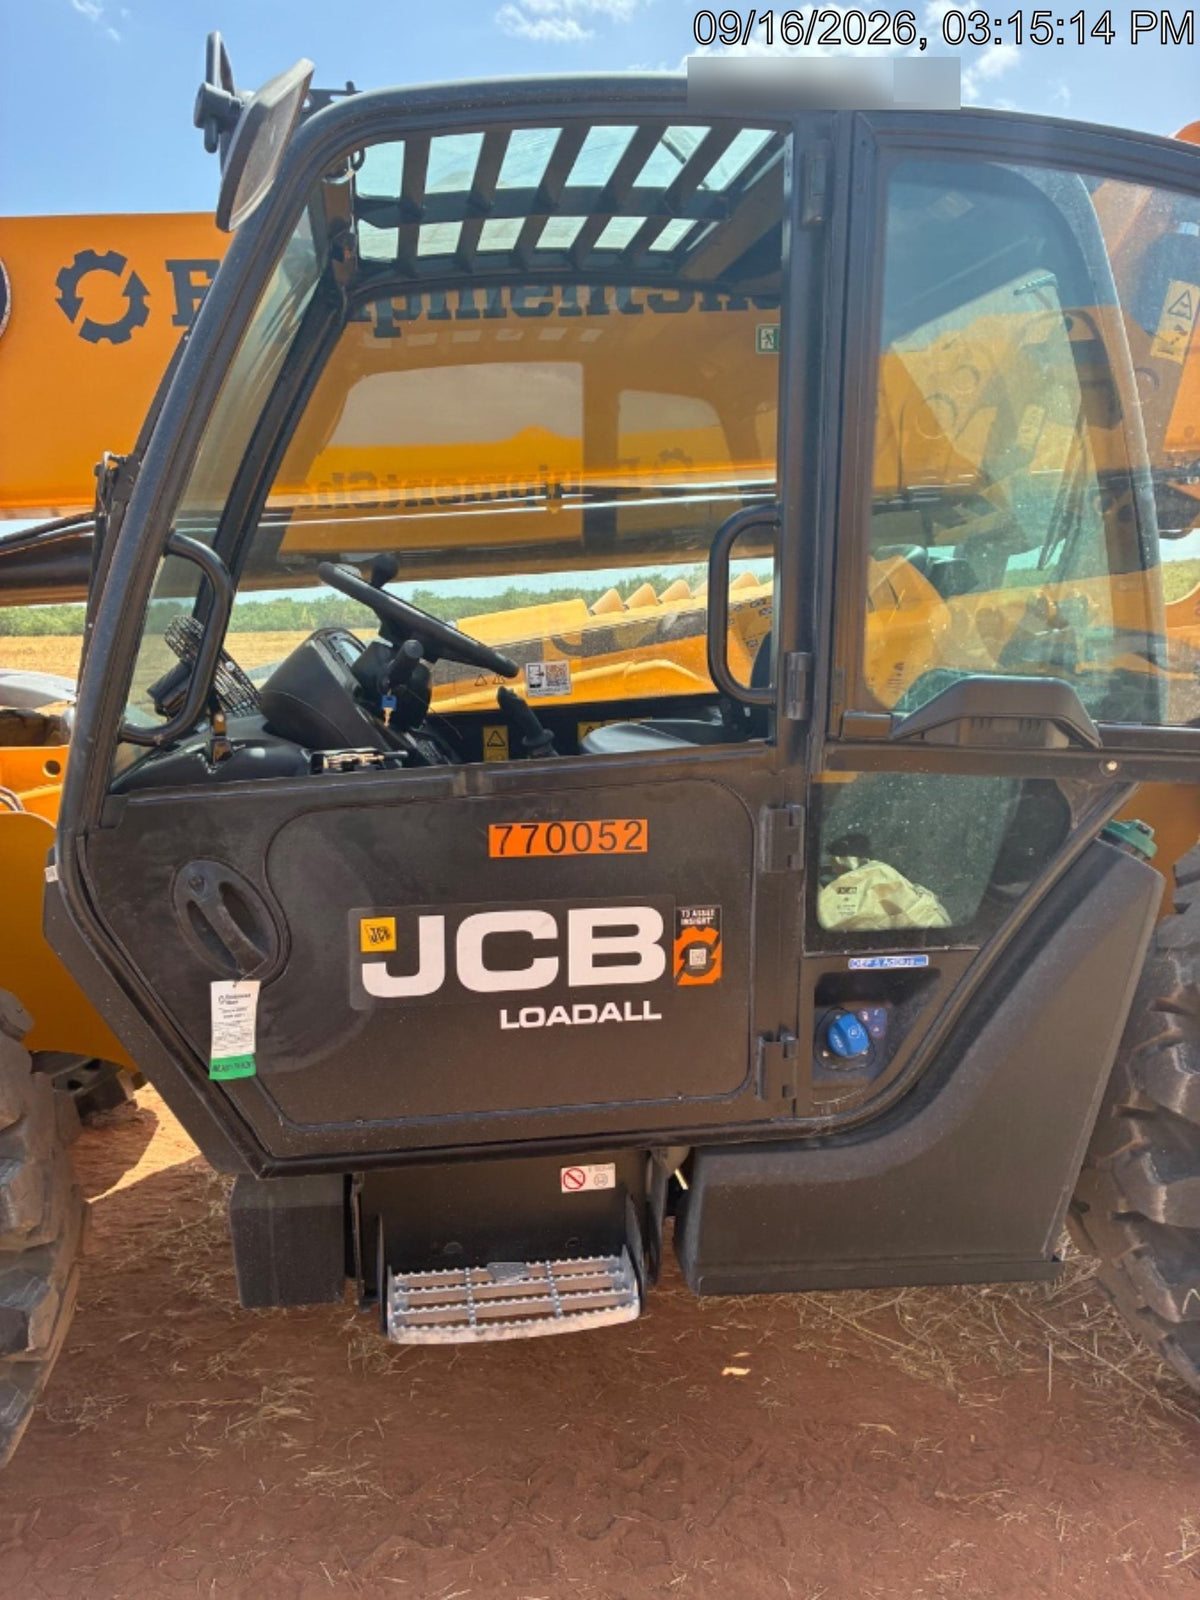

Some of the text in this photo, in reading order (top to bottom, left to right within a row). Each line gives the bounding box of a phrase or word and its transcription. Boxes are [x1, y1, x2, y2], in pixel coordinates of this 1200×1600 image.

[494, 820, 643, 855] 770052
[361, 906, 666, 998] JCB
[500, 1000, 663, 1030] LOADALL
